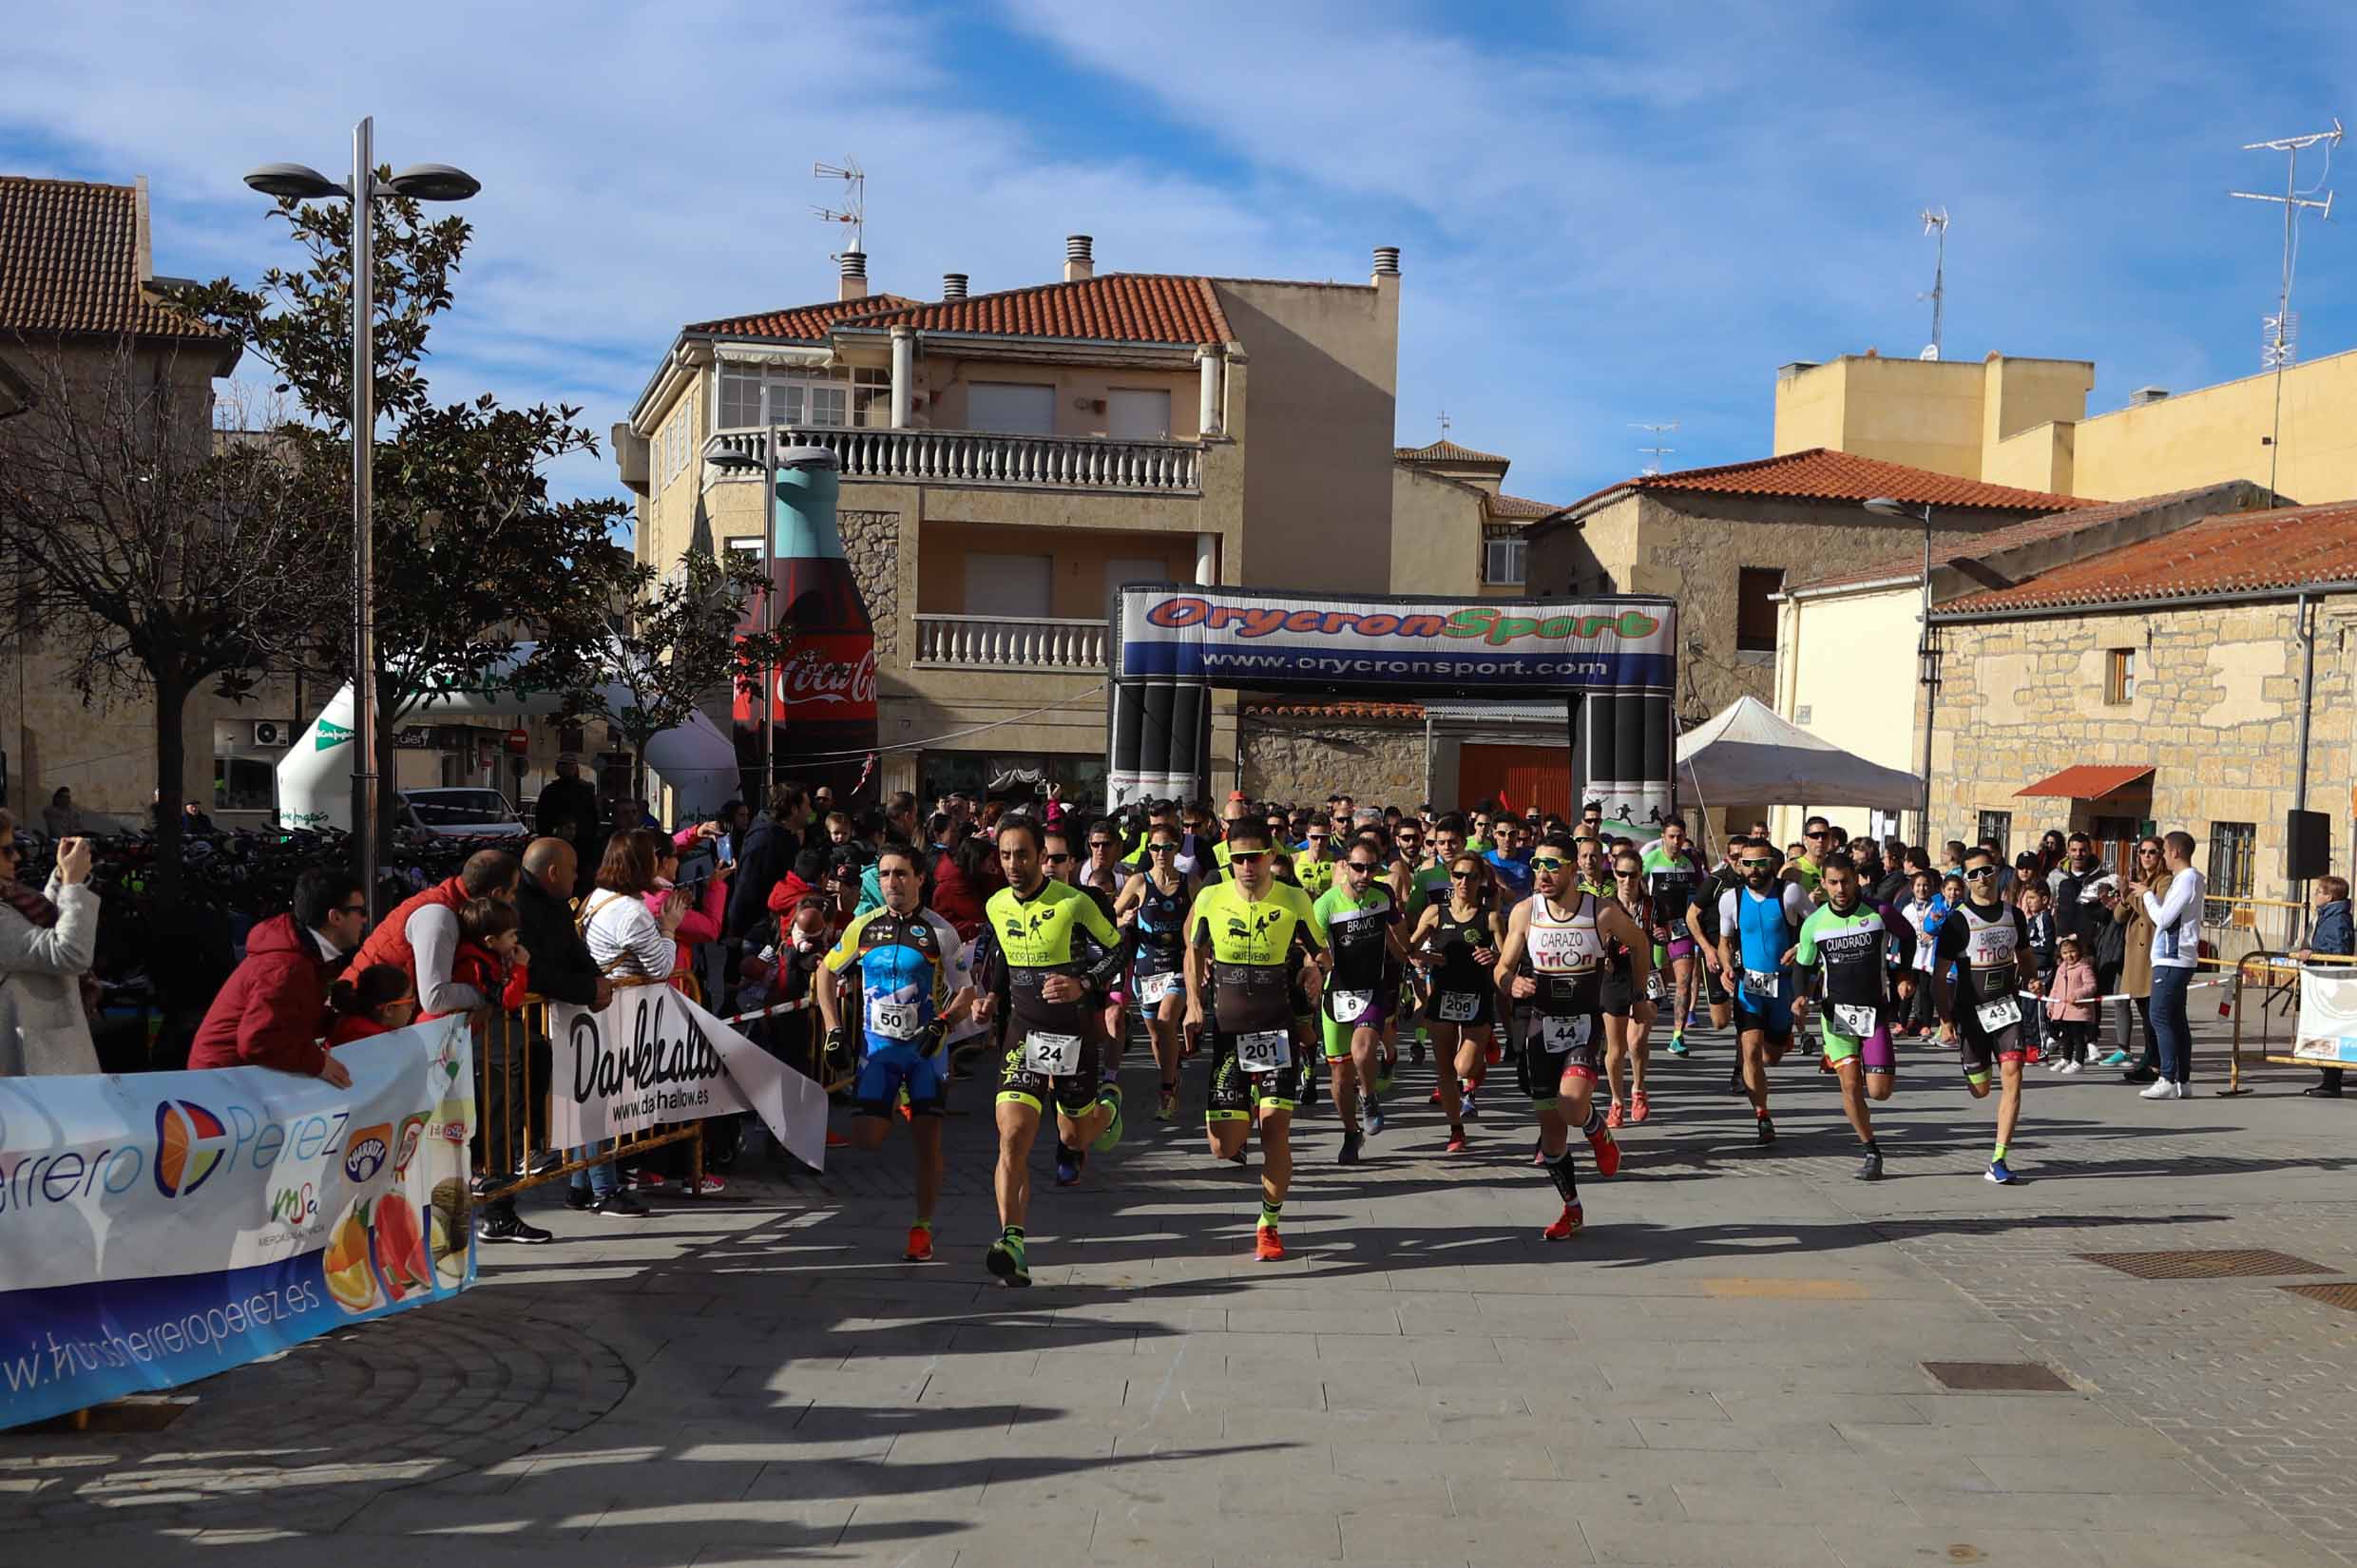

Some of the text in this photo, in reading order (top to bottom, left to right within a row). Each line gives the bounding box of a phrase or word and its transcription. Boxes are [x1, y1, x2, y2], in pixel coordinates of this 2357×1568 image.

[1200, 652, 1608, 677] www.orycronsport.com
[1347, 916, 1375, 933] BRAVO
[1541, 931, 1583, 948] CARAZO
[1826, 932, 1872, 951] CUADRADO
[1232, 951, 1271, 962] QUEVEDO
[880, 1012, 902, 1028] 50
[1848, 1013, 1858, 1026] 8
[1989, 1006, 2007, 1021] 43
[1555, 1026, 1577, 1041] 44
[1038, 1045, 1063, 1062] 24
[1245, 1042, 1278, 1061] 201
